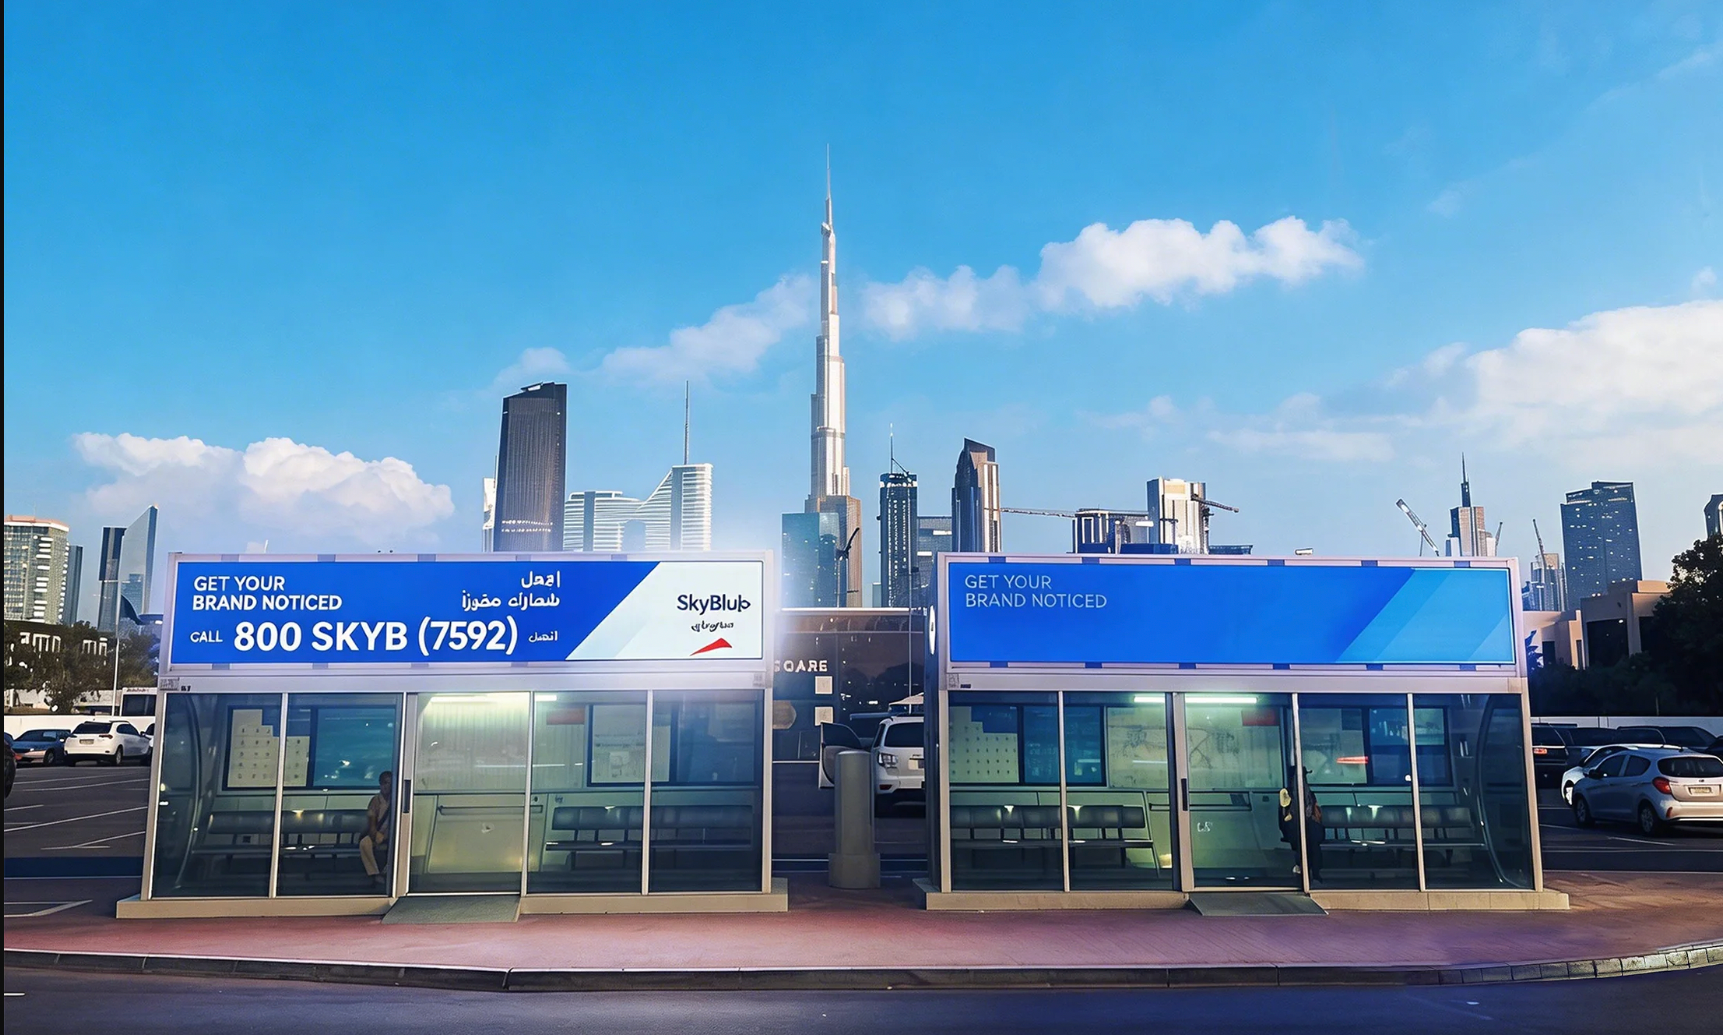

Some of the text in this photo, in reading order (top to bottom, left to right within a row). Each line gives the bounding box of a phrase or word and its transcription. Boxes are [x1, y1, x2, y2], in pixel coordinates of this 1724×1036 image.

[193, 575, 286, 592] GET YOUR
[964, 574, 1052, 590] GET YOUR
[192, 594, 343, 611] BRAND NOTICED
[966, 592, 1107, 609] BRAND NOTICED
[190, 615, 518, 657] CALL 800 SKYB (7592)
